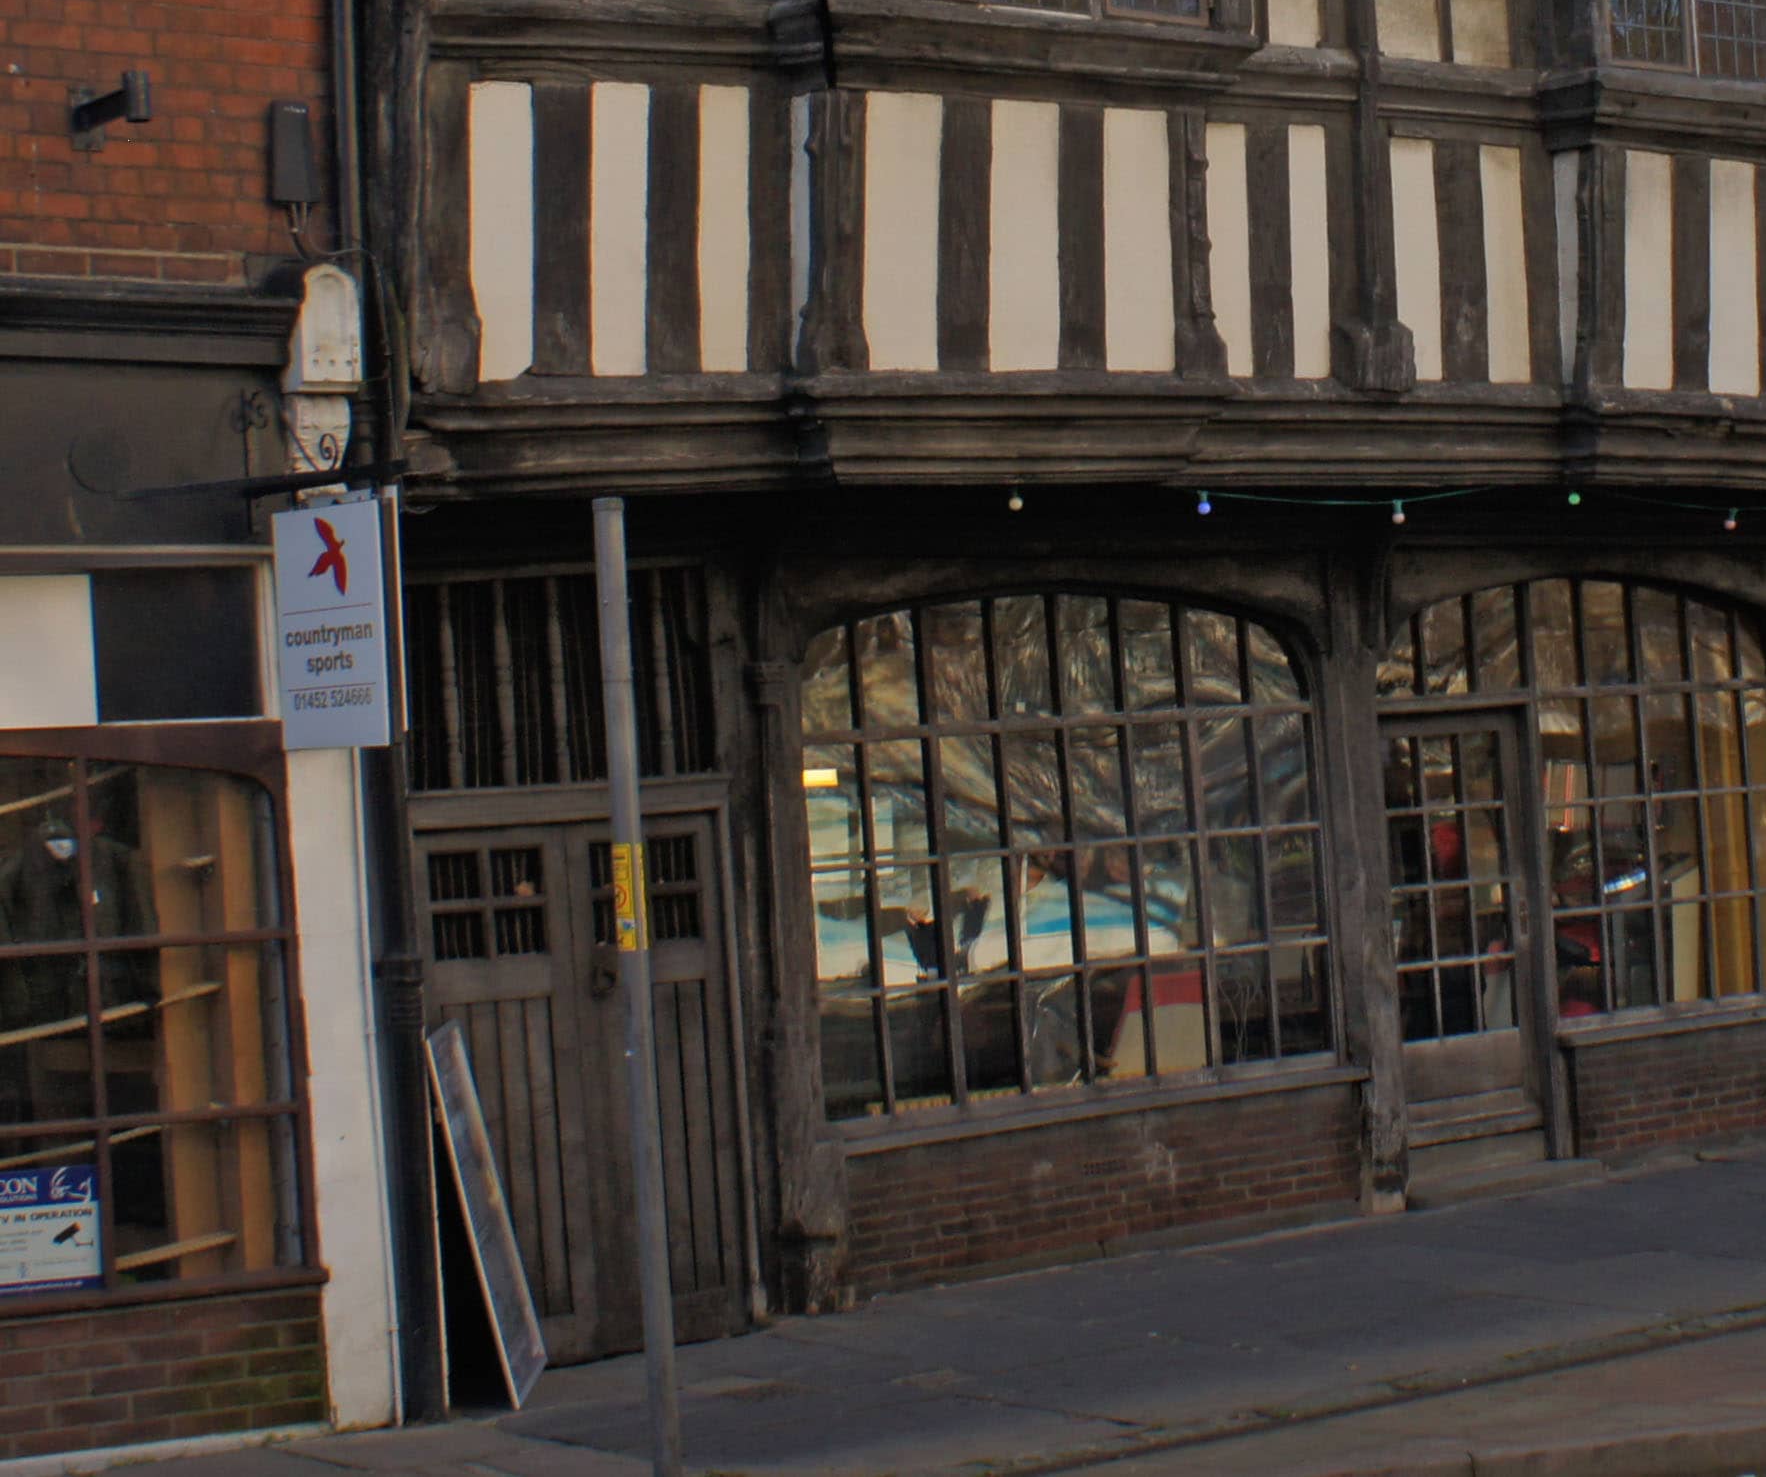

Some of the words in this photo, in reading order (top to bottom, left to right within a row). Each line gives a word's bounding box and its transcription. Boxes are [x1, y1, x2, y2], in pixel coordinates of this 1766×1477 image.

[285, 623, 373, 648] countryman
[307, 650, 354, 676] sports
[294, 691, 328, 711] 01452
[14, 1212, 27, 1222] IN
[30, 1207, 94, 1221] OPERATION
